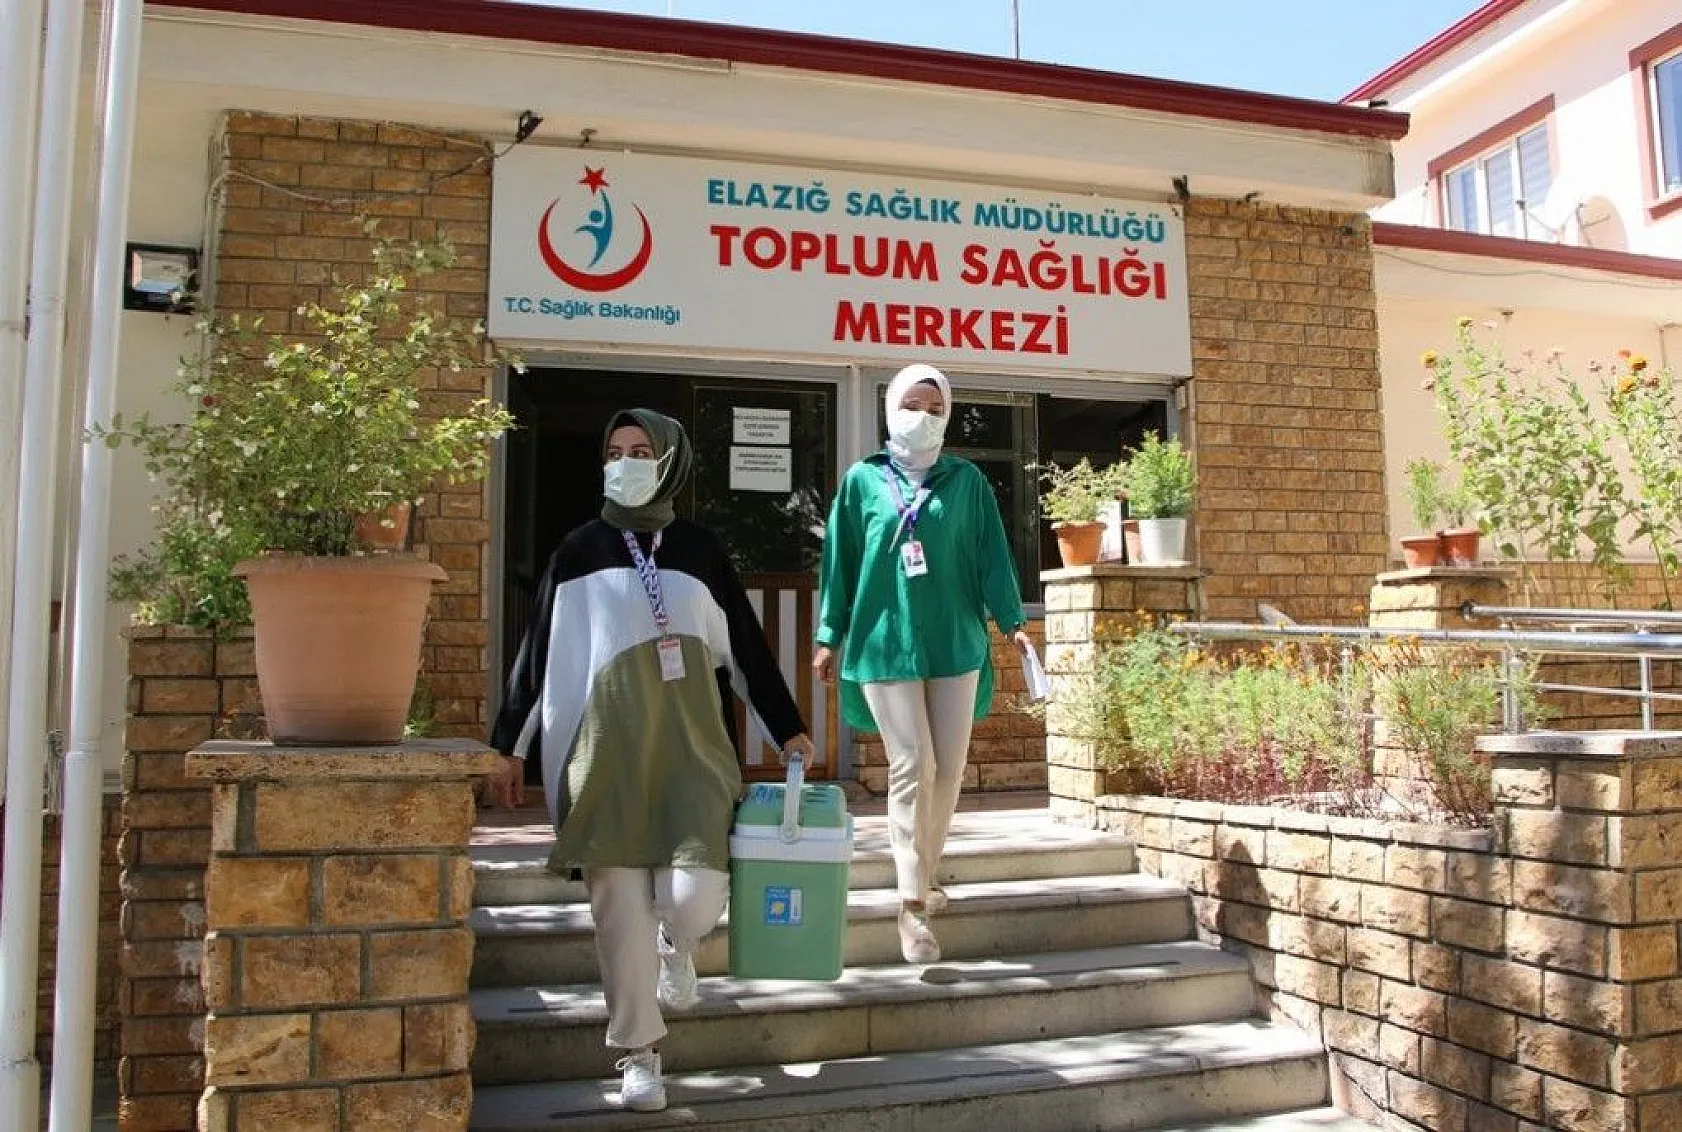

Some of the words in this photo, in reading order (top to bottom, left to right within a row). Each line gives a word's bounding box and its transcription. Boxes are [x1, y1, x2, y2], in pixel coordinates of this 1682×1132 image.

[706, 179, 830, 213] ELAZIĞ
[845, 189, 961, 224] SAĞLIK
[974, 199, 1166, 244] MÜDÜRLÜĞÜ
[710, 225, 939, 282] TOPLUM
[960, 239, 1168, 300] SAĞLIĞI
[503, 297, 535, 314] T.C.
[539, 299, 594, 320] Sağlık
[599, 302, 682, 326] Bakanlığı
[832, 301, 1069, 356] MERKEZİ
